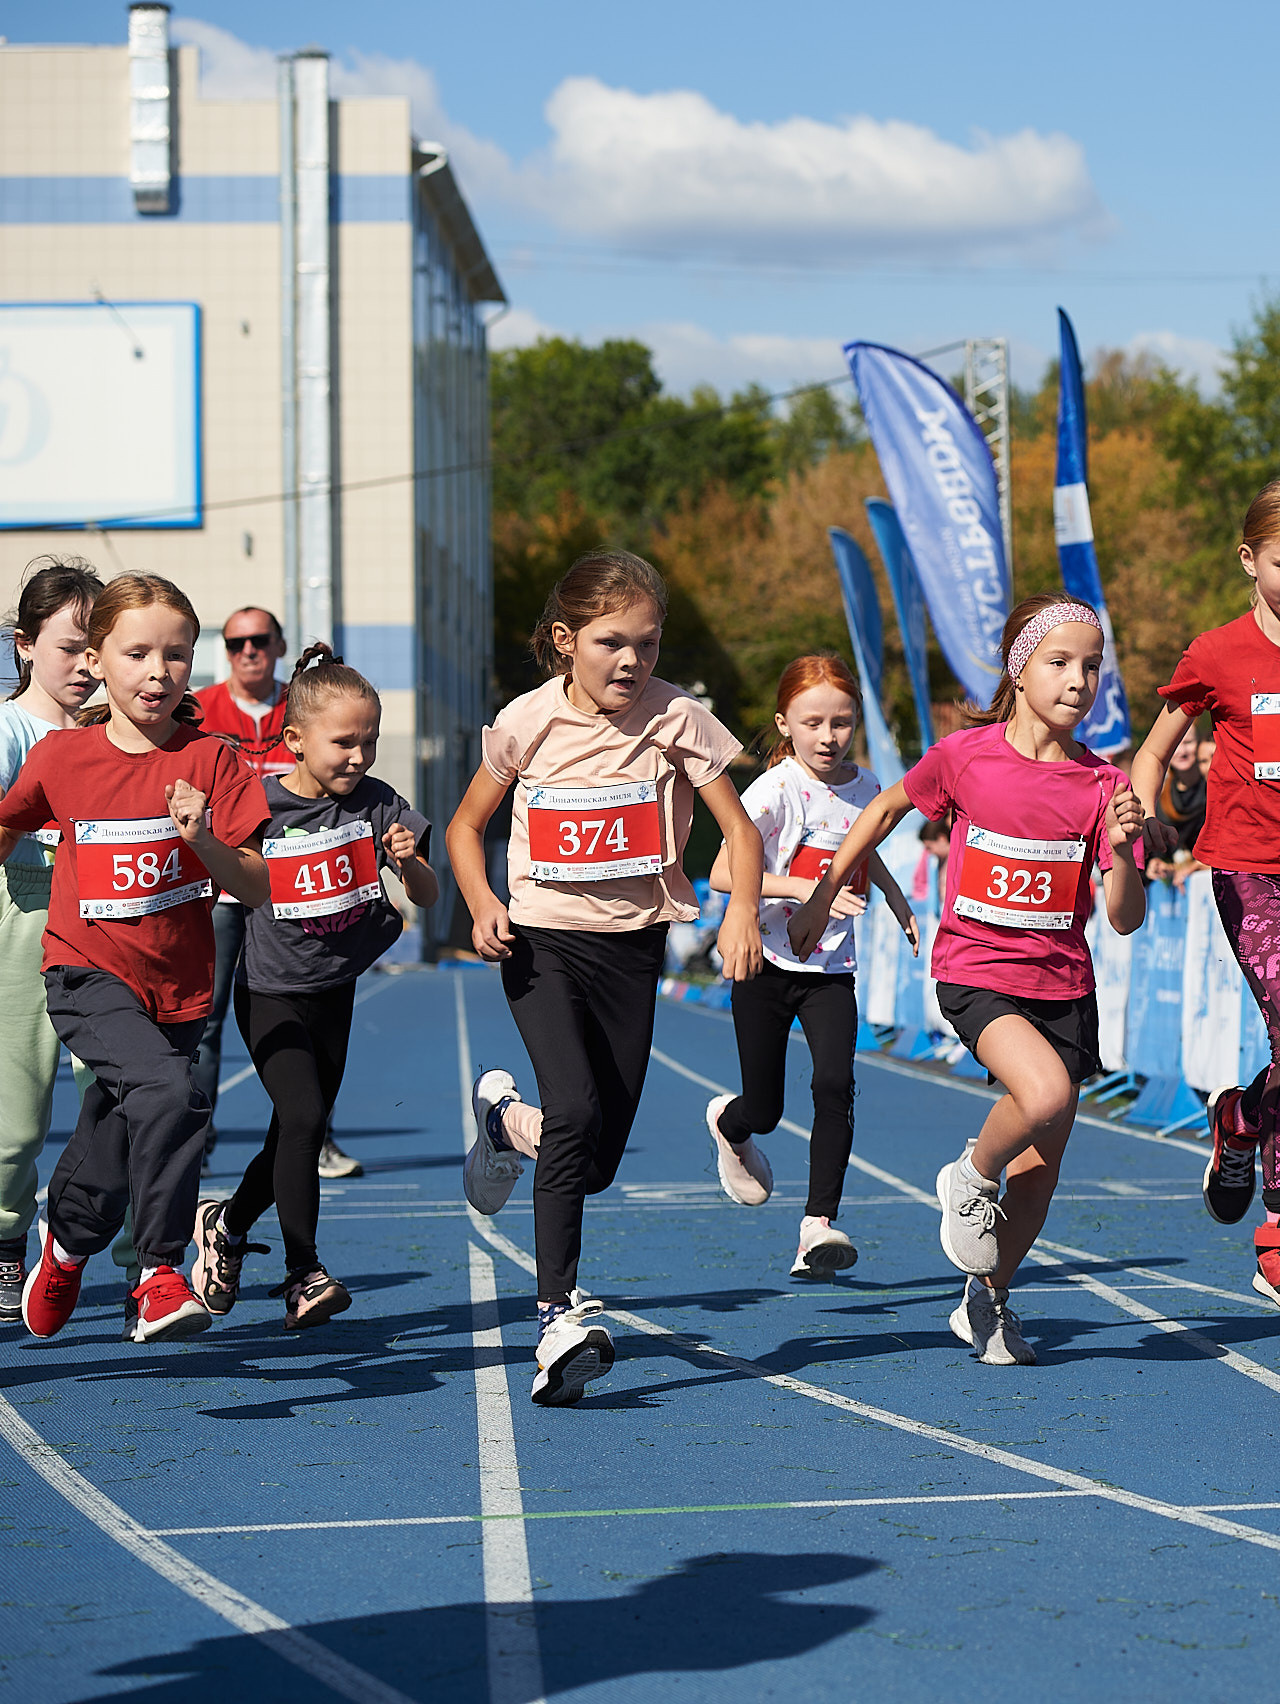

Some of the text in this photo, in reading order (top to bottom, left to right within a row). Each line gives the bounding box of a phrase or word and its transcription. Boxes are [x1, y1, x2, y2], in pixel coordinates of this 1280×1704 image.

[548, 795, 608, 804] Динамовская
[101, 826, 163, 837] Динамовская
[558, 817, 629, 856] 374
[112, 847, 182, 891] 584
[294, 854, 353, 896] 413
[986, 865, 1052, 905] 323
